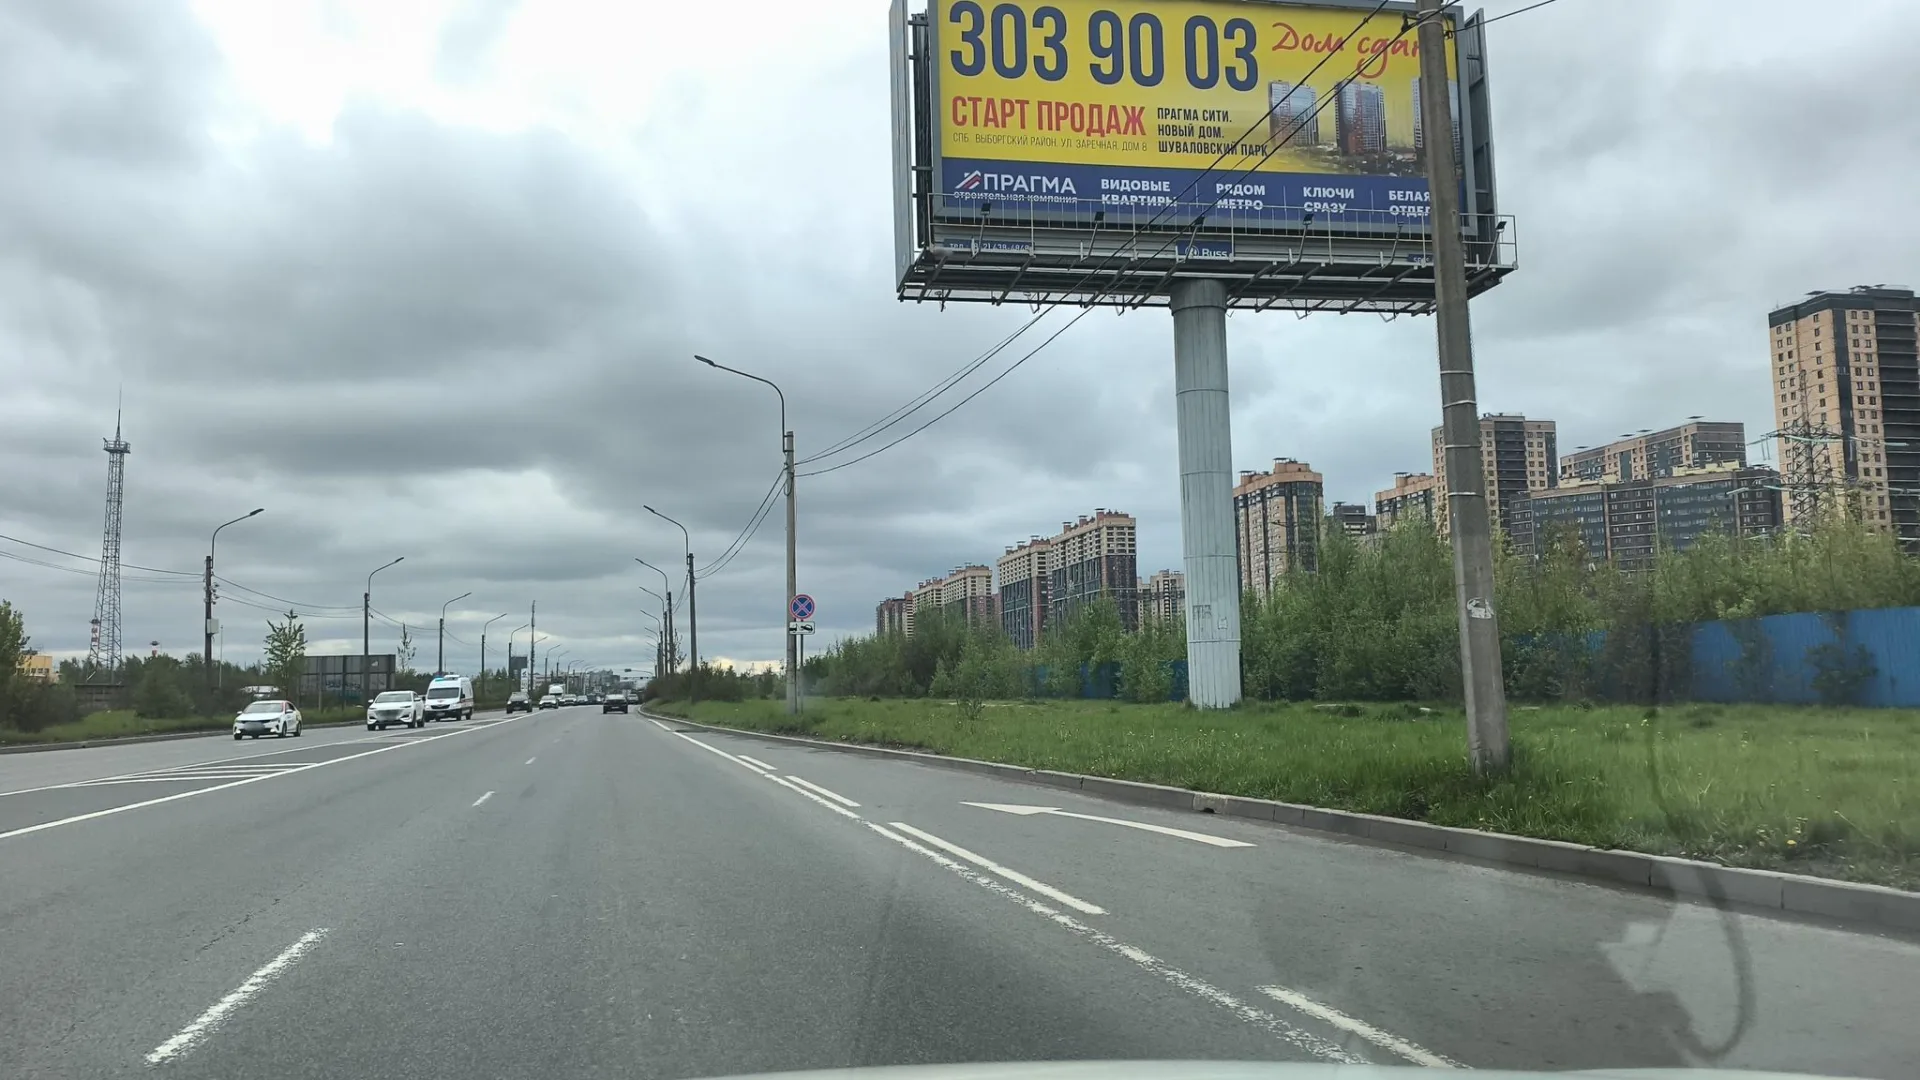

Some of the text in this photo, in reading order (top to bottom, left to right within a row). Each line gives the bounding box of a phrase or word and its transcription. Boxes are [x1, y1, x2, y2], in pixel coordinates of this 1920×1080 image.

[1272, 22, 1344, 53] Дом
[950, 1, 1258, 92] 303 90 03
[951, 96, 1147, 137] СТАРТ ПРОДАЖ
[1157, 107, 1232, 122] ПРАГМА СИТИ.
[1158, 123, 1224, 139] НОВЫЙ ДОМ.
[975, 133, 1028, 146] ВЫБОРГСКИЙ
[1122, 140, 1139, 152] ДОМ
[1142, 141, 1147, 152] 8
[1158, 140, 1268, 156] ШУВАЛОВСКИЙ ПАРК
[984, 173, 1077, 194] ПРАГМА
[1101, 178, 1171, 192] ВИДОВЫЕ
[1216, 183, 1265, 196] РЯДОМ
[1028, 194, 1077, 204] компания
[1101, 193, 1177, 207] КВАРТИРЫ
[1303, 186, 1355, 199] КЛЮЧИ
[1216, 198, 1264, 211] МЕТРО
[1303, 201, 1347, 213] СРАЗУ
